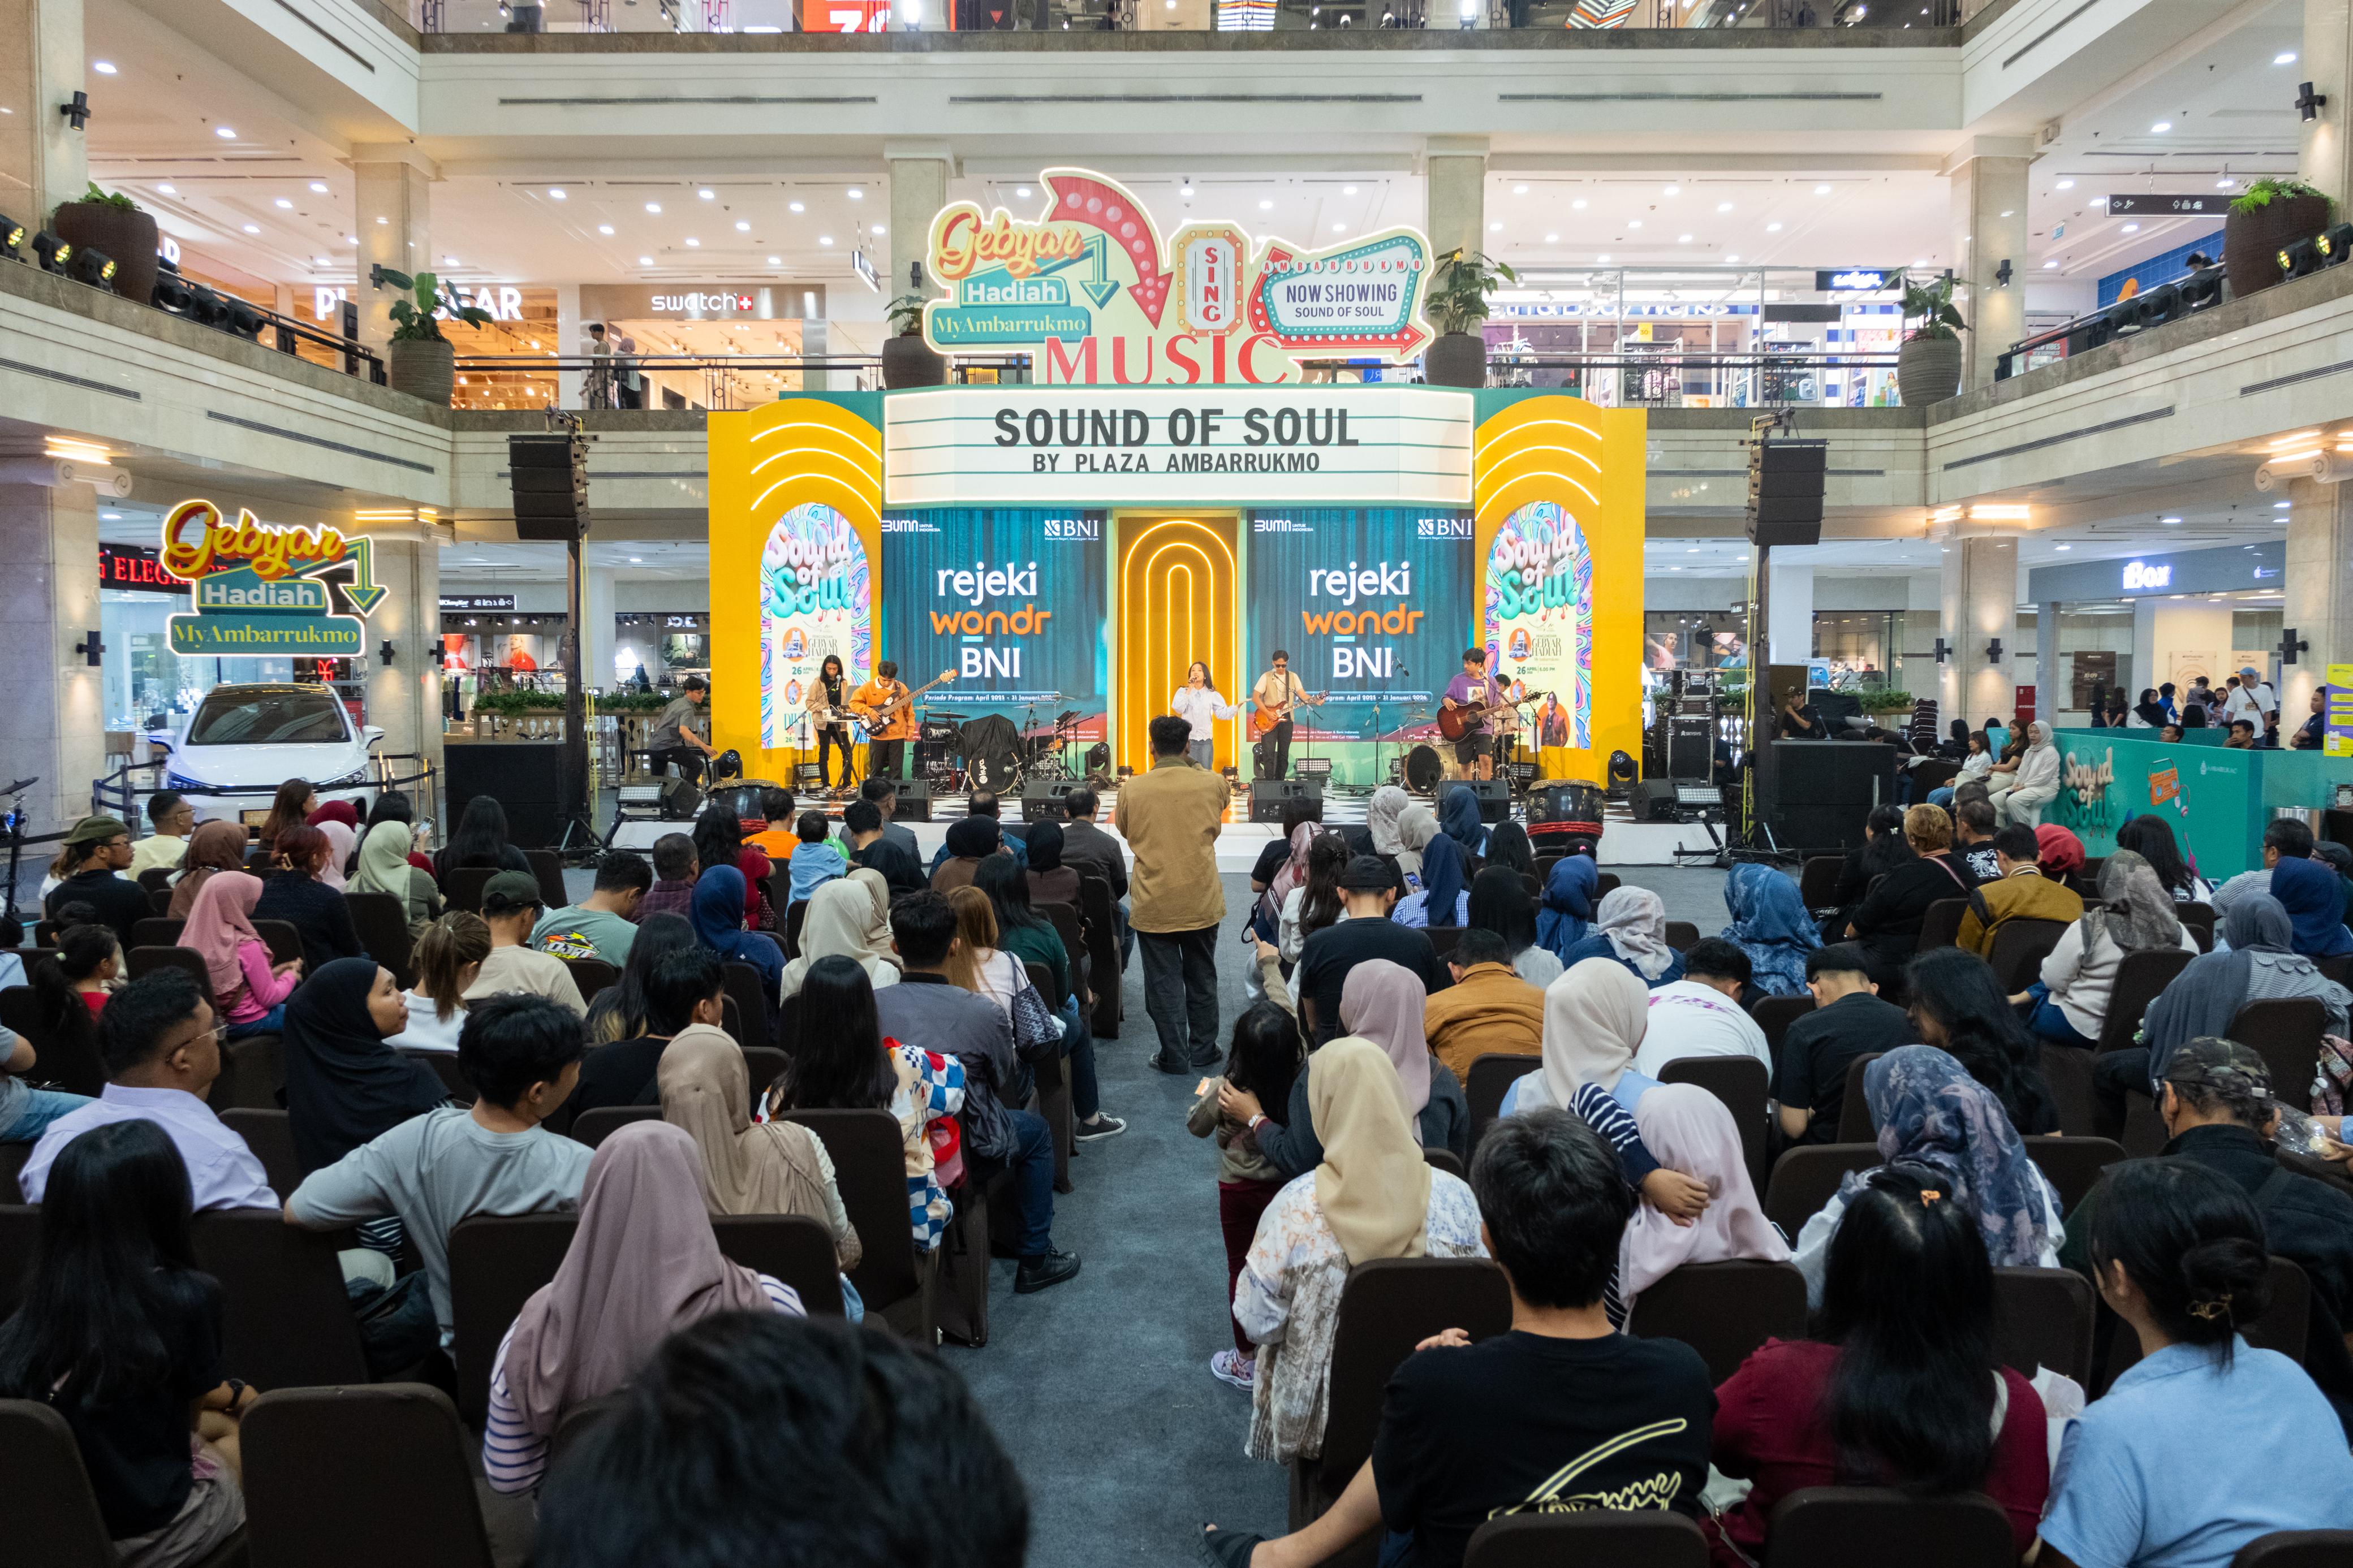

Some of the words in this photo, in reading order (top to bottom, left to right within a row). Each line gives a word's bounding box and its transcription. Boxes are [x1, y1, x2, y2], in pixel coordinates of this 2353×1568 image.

[935, 209, 1083, 279] Gebyar
[1264, 260, 1420, 271] AMBARRUKMO
[967, 281, 1057, 302] Hadiah
[1203, 247, 1221, 322] SING
[1286, 284, 1321, 303] NOW
[1325, 283, 1397, 302] SHOWING
[652, 292, 737, 311] swatch
[1295, 307, 1334, 317] SOUND
[1338, 307, 1352, 317] OF
[1355, 306, 1384, 317] SOUL
[1046, 334, 1287, 385] MUSIC
[994, 408, 1149, 447] SOUND
[1168, 408, 1224, 446] OF
[1243, 408, 1359, 446] SOUL
[1033, 453, 1059, 472] BY
[1075, 453, 1149, 472] PLAZA
[1166, 453, 1320, 472] AMBARRUKMO
[164, 502, 345, 580] Gebyar
[1064, 520, 1098, 537] BNI
[1437, 519, 1472, 535] BNI
[769, 563, 852, 618] Soul
[796, 561, 823, 593] of
[937, 561, 1037, 606] rejeki
[1309, 561, 1410, 606] rejeki
[1498, 560, 1578, 619] Soul
[1522, 560, 1548, 592] of
[2123, 562, 2170, 589] iBox
[205, 581, 316, 605] Hadiah
[929, 604, 1051, 635] wondr
[1302, 603, 1424, 634] wondr
[961, 647, 1021, 678] BNI
[1333, 647, 1392, 678] BNI
[2063, 746, 2114, 788] Sound
[2063, 785, 2113, 829] Soul
[2079, 784, 2095, 809] of
